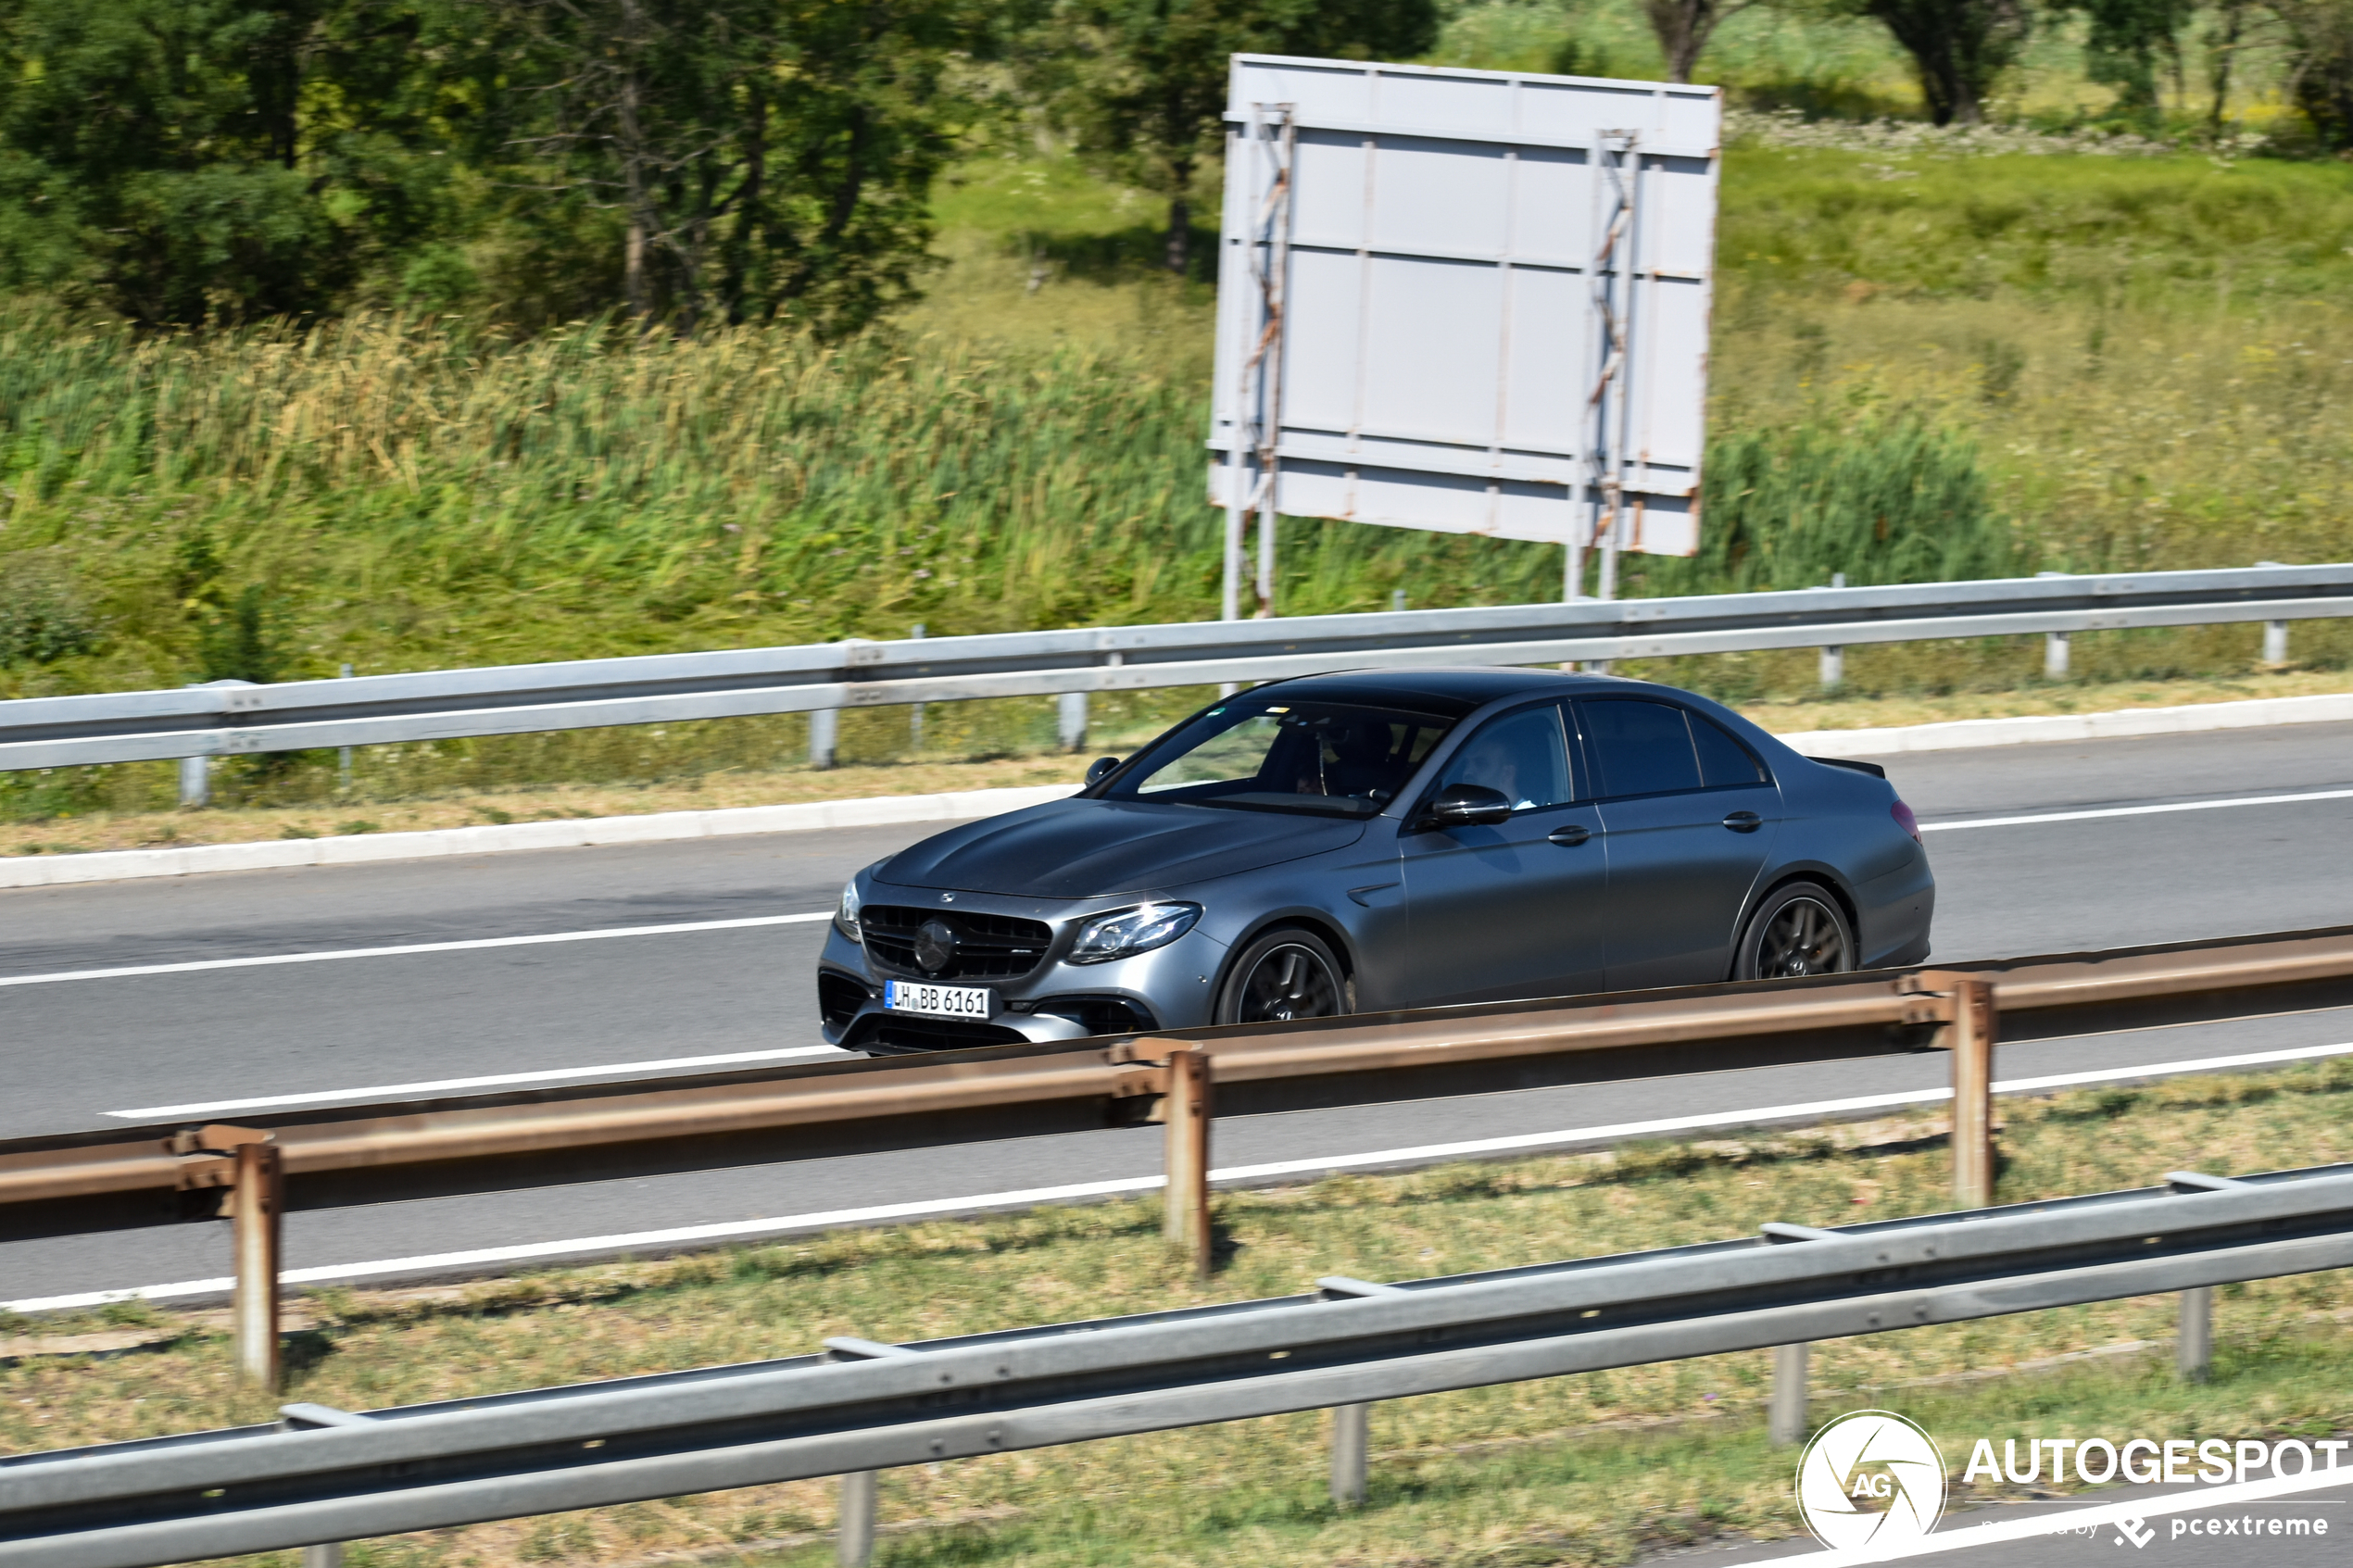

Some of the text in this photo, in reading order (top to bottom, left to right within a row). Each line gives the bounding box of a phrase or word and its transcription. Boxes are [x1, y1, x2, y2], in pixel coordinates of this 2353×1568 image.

[894, 985, 985, 1014] LH BB 6161
